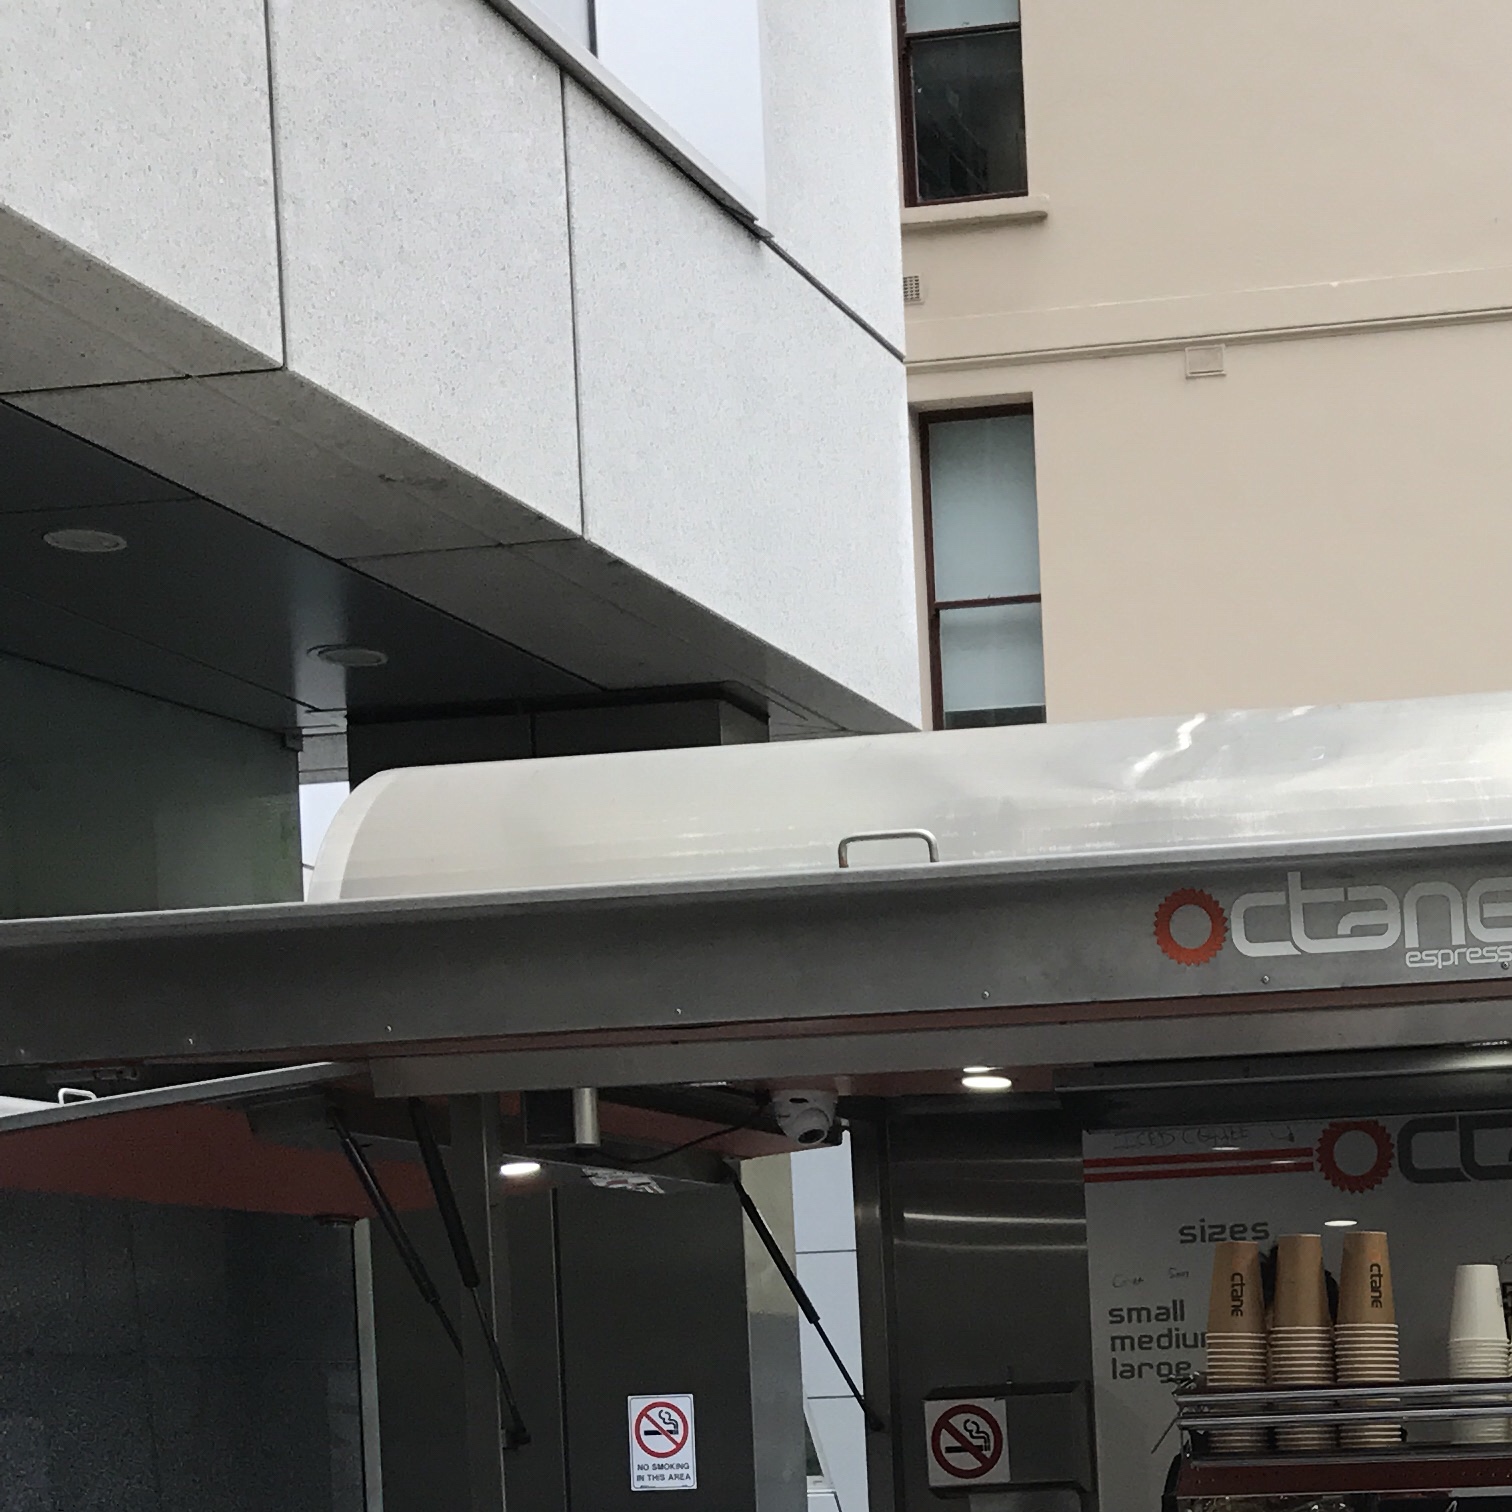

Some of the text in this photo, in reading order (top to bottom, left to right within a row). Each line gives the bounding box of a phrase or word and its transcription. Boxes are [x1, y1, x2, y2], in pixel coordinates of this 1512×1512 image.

[1178, 1218, 1270, 1244] sizes
[1108, 1299, 1185, 1324] small
[1111, 1357, 1192, 1384] large
[637, 1462, 690, 1471] NO SMOKING
[647, 1474, 666, 1482] THIS
[668, 1473, 692, 1481] AREA
